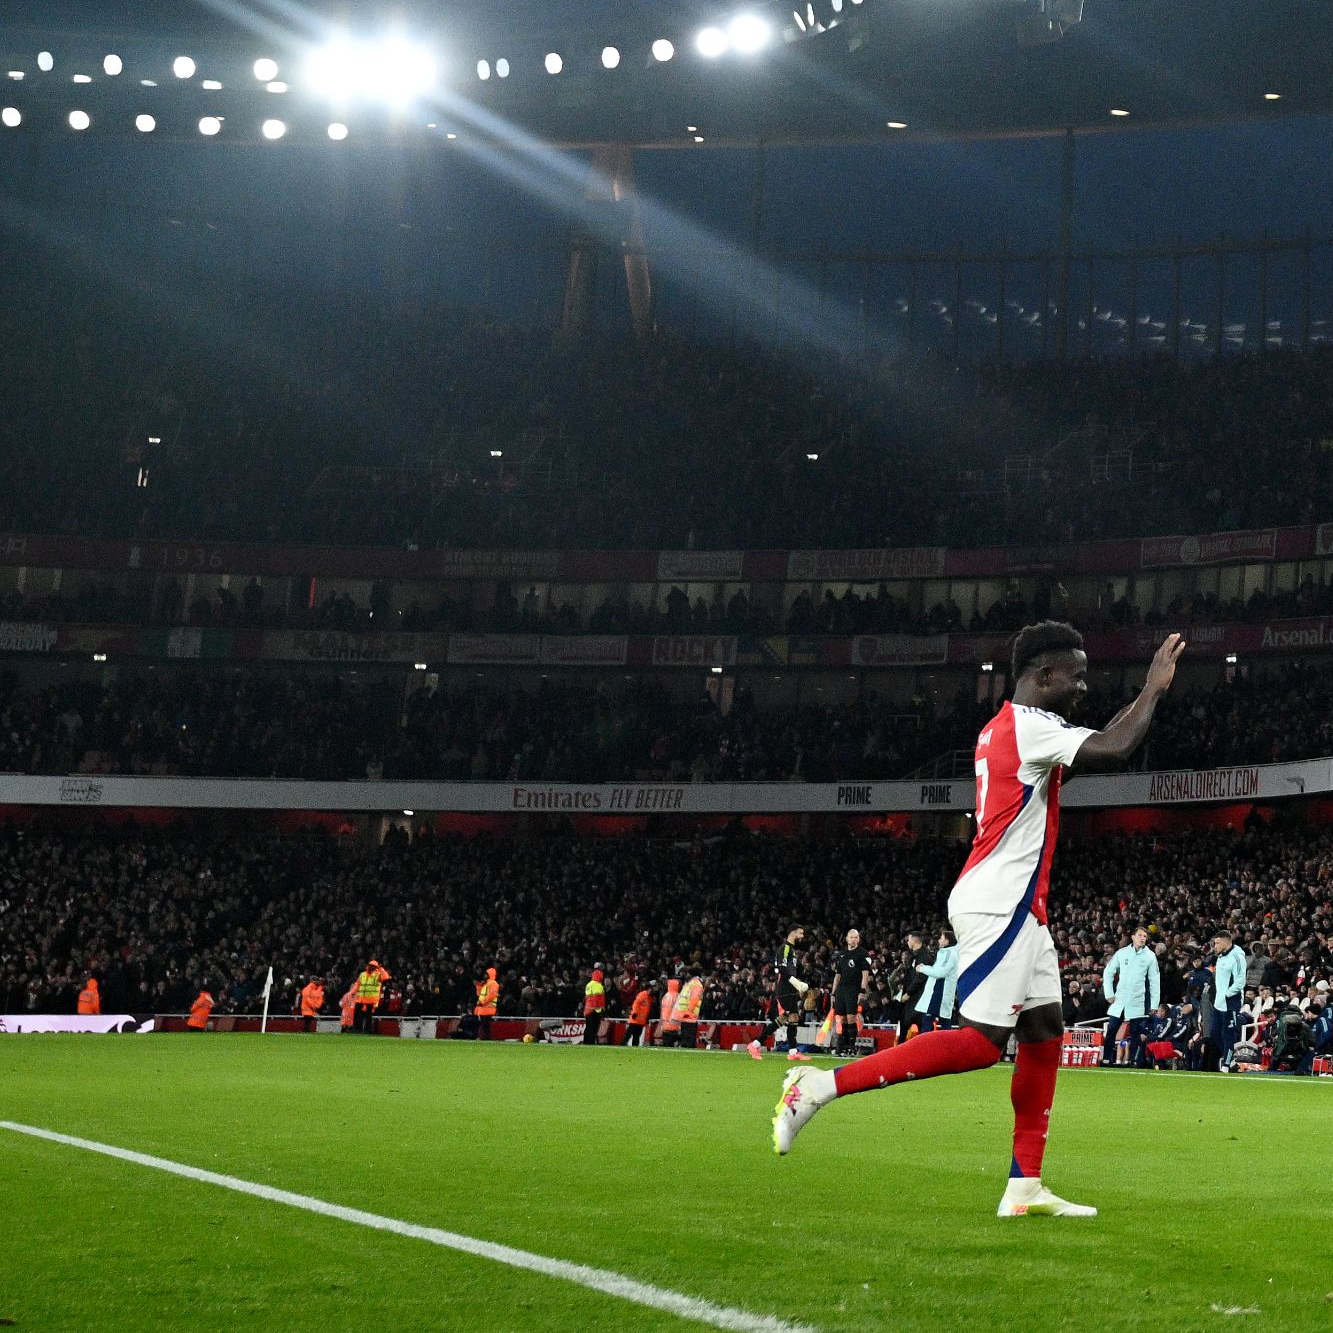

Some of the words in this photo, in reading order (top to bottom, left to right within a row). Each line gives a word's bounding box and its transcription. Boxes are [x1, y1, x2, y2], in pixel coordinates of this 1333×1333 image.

[655, 636, 732, 665] ROCKY
[837, 786, 873, 805] PRIME
[920, 785, 952, 804] PRIME
[1150, 768, 1259, 801] ARSENALDIRECT.COM
[513, 788, 601, 809] Emirates
[609, 788, 633, 809] FLY
[635, 788, 684, 809] BETTER
[1071, 1032, 1094, 1044] PRIME
